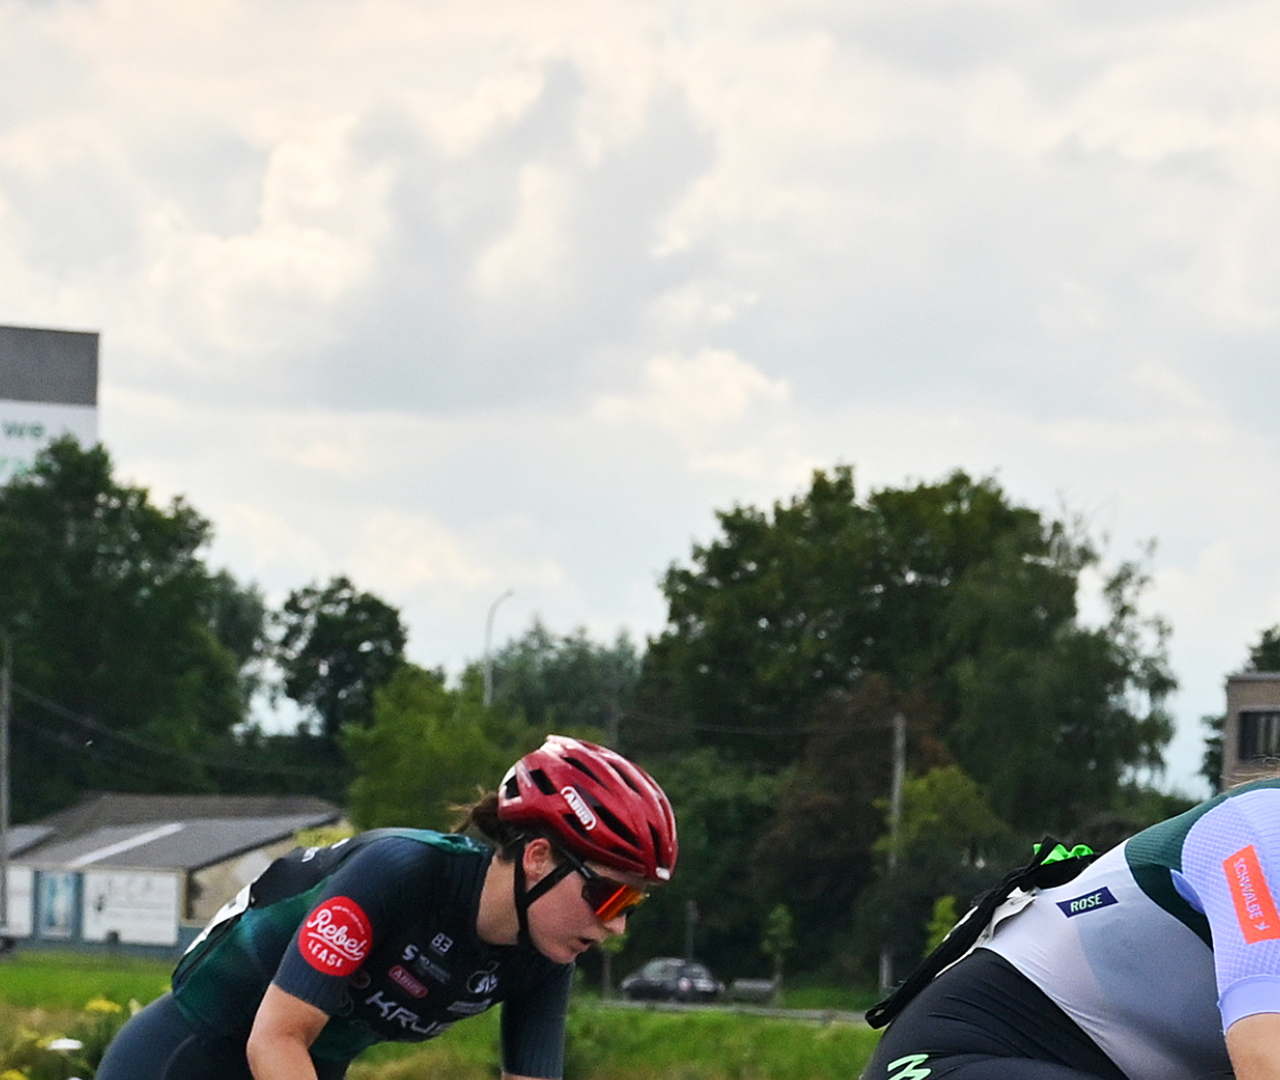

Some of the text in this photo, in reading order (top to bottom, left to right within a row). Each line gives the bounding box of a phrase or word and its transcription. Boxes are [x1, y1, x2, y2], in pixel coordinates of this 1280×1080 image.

[3, 420, 46, 440] we
[1070, 892, 1103, 913] ROSE
[1233, 857, 1265, 920] SCHWALBE
[306, 908, 368, 960] Rebel
